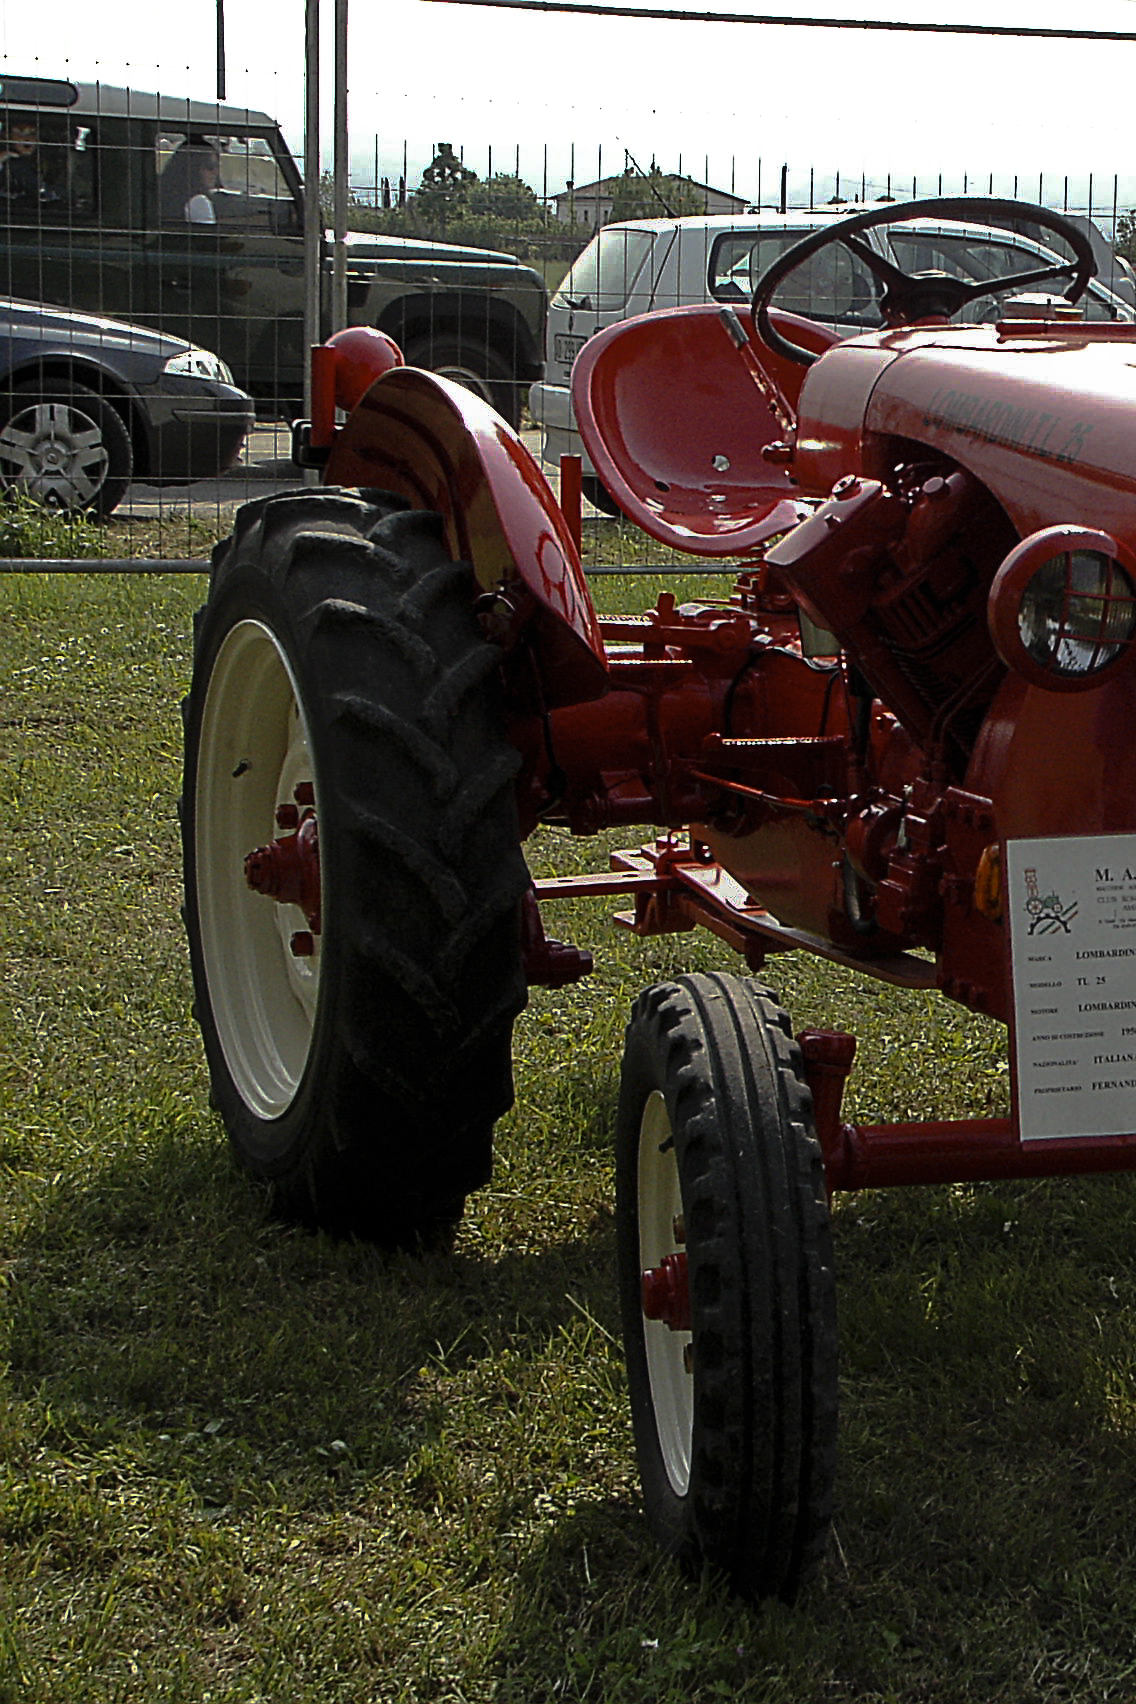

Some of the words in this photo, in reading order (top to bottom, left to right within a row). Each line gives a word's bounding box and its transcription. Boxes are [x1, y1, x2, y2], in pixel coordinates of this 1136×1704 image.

[1056, 422, 1094, 464] 25
[1096, 868, 1114, 882] M.
[1077, 977, 1090, 986] TL
[1096, 976, 1106, 985] 25
